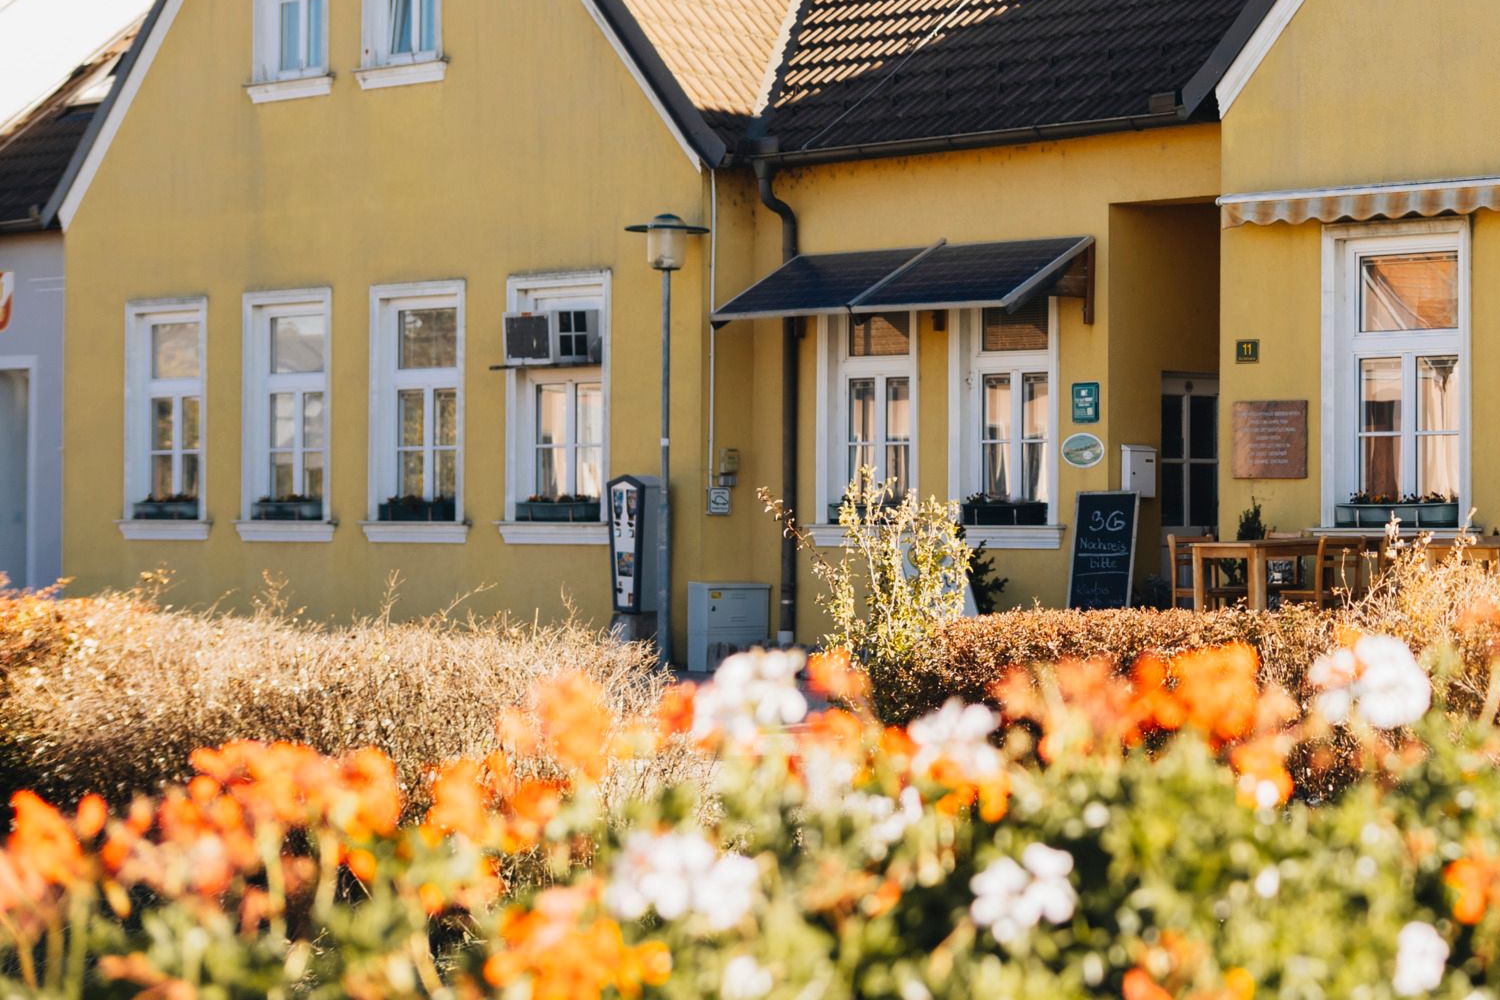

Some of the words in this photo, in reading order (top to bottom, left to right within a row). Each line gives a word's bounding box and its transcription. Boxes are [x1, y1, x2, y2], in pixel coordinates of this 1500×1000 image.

[1242, 343, 1252, 356] 11
[1088, 510, 1127, 532] 3G
[1088, 556, 1118, 569] bitte
